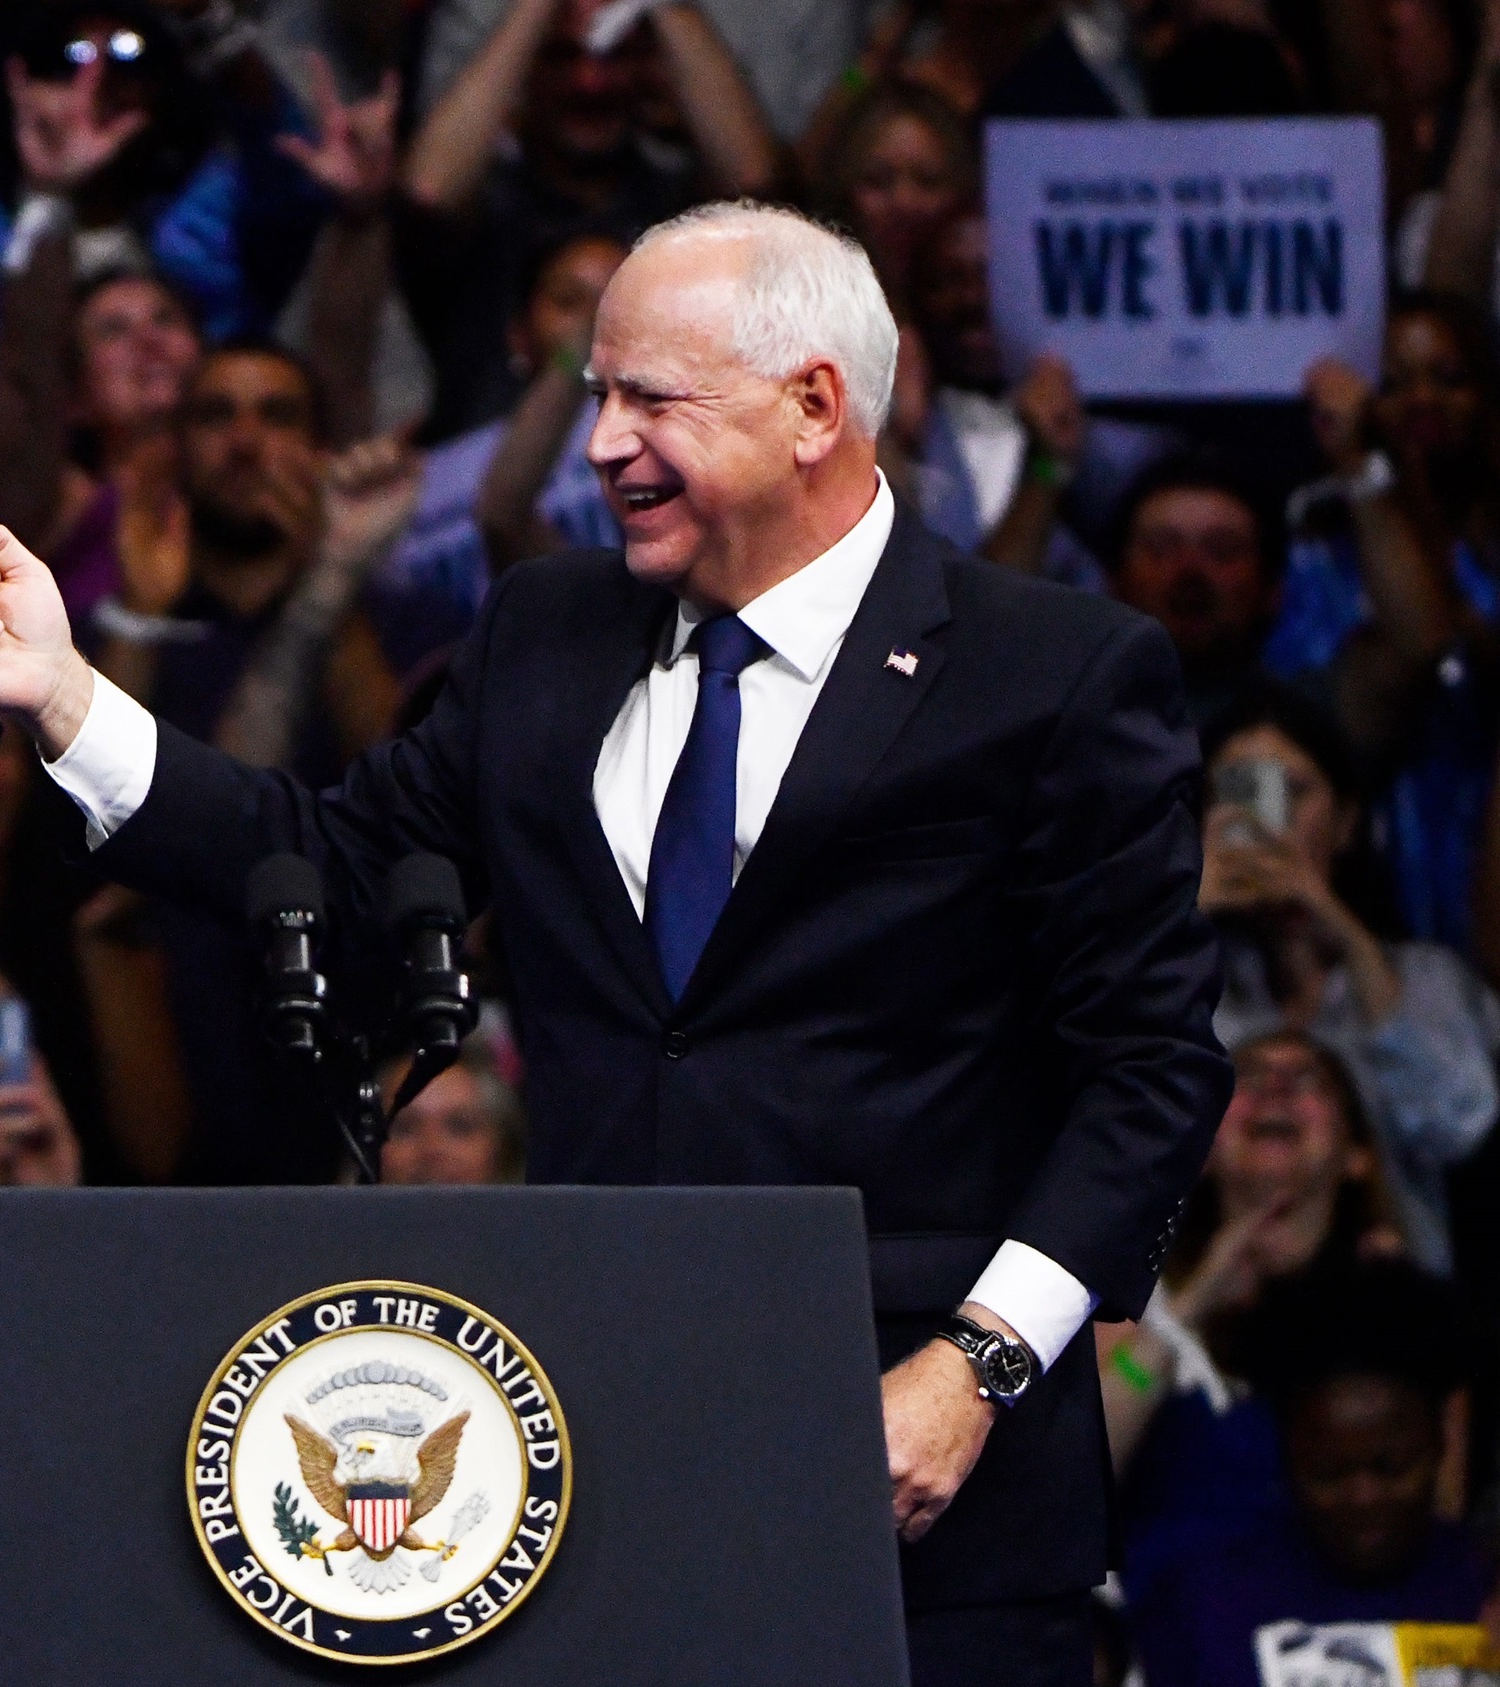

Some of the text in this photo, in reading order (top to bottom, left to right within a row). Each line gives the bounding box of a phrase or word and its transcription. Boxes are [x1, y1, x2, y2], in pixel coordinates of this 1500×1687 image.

[1036, 217, 1344, 320] WE WIN
[314, 1300, 358, 1332] OF
[372, 1297, 440, 1332] THE
[195, 1318, 301, 1544] PRESIDENT
[456, 1315, 561, 1470] UNITED
[228, 1554, 315, 1643] VICE
[444, 1496, 559, 1635] STATES
